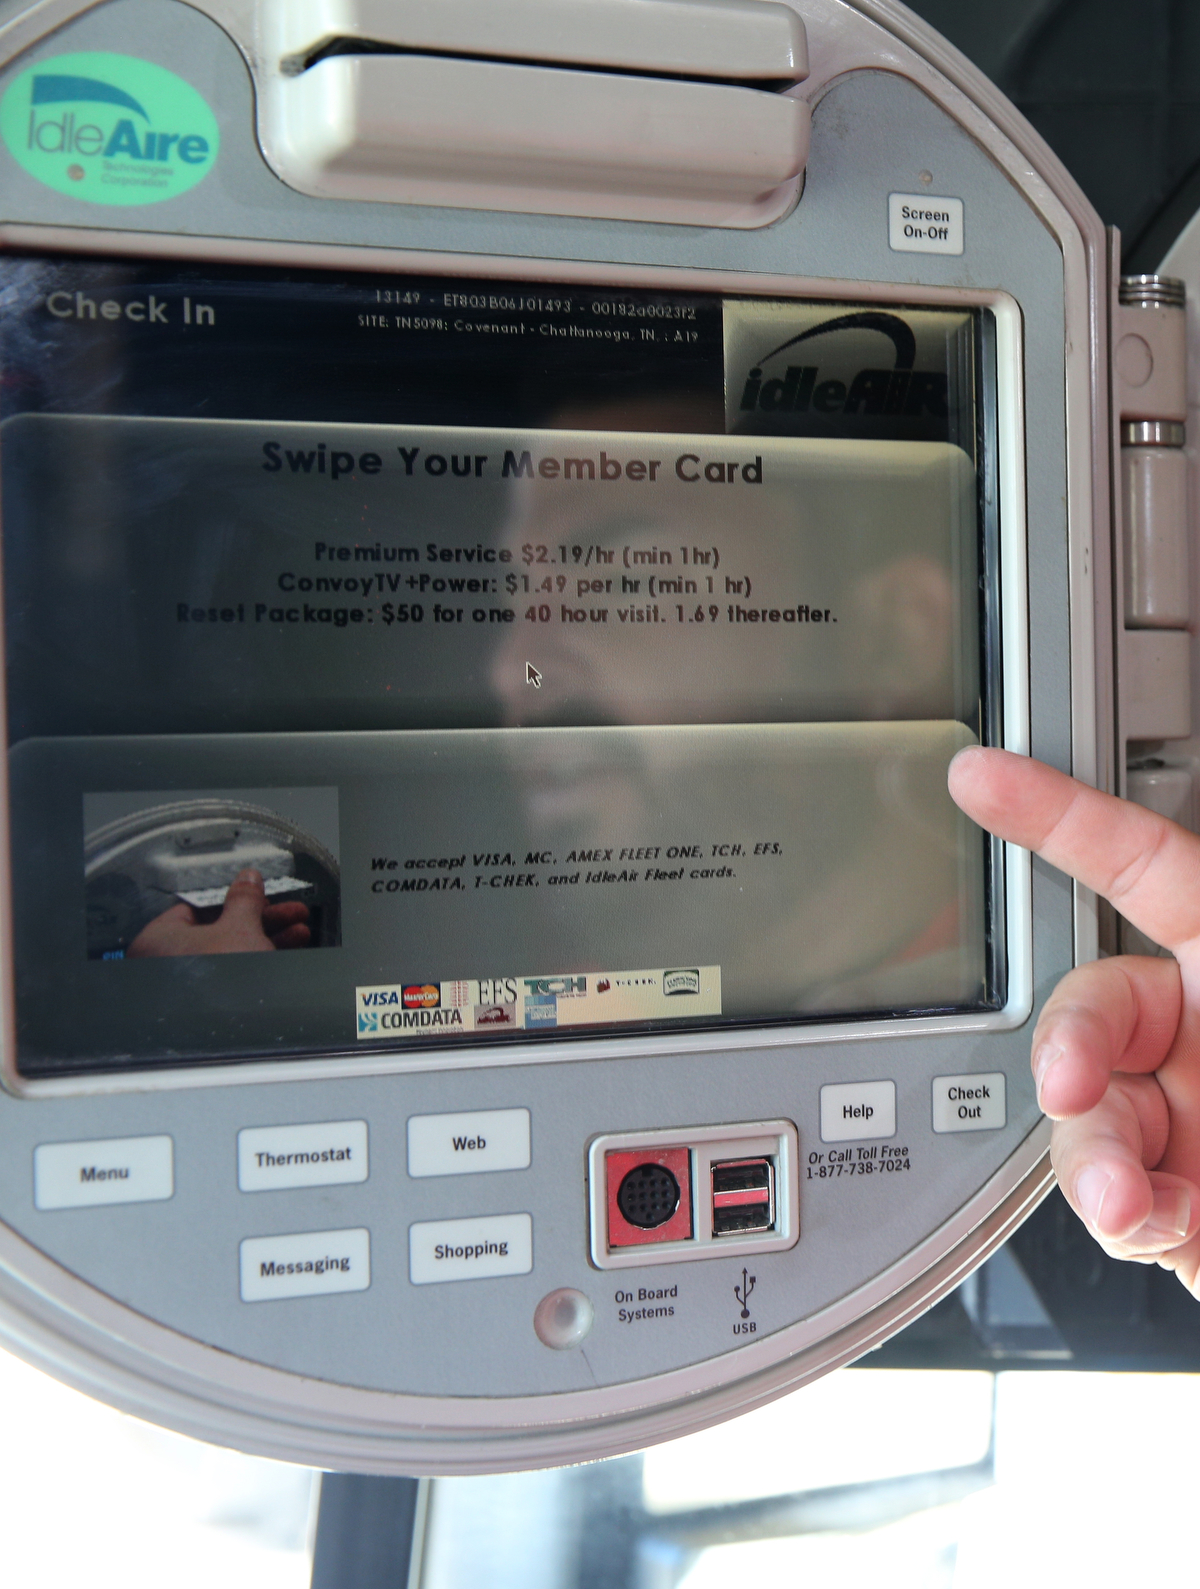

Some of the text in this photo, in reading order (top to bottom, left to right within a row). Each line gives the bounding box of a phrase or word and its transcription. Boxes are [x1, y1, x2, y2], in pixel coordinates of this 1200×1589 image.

[27, 110, 209, 164] IdleAire
[901, 205, 950, 222] Screen
[903, 224, 948, 240] On-Off
[375, 289, 421, 305] 13149
[46, 290, 216, 325] Check In
[358, 314, 389, 328] SITE:
[454, 319, 526, 335] Covenant
[261, 441, 763, 484] Swipe Your Member Card
[314, 541, 720, 569] Premium Service $2.19/hr (min 1hr)
[278, 572, 752, 599] ConvoyTV +Power: $1.49 per hr (min 1 hr)
[176, 601, 838, 627] Reset Package: $50 for one 40 hour visit. 1.69 thereafter.
[371, 842, 783, 871] We accept VISA, MC, AMEX FLEET ONE, TCH, EFS,
[371, 865, 736, 893] COMDATA, T-CHEK, and IdleAir Fleet cards.
[361, 991, 399, 1007] VISA
[381, 1009, 463, 1029] COMDATA
[947, 1084, 991, 1101] Check
[842, 1103, 875, 1121] Help
[957, 1104, 982, 1119] Out
[451, 1135, 487, 1152] Web
[254, 1146, 352, 1169] Thermostat
[808, 1145, 910, 1164] Or Call Toll Free
[79, 1165, 130, 1184] Menu
[805, 1158, 912, 1180] 1-877-738-7024
[433, 1238, 509, 1262] Shopping
[259, 1255, 351, 1279] Messaging
[614, 1284, 678, 1304] On Board
[618, 1303, 675, 1322] Systems
[732, 1322, 758, 1336] USB
